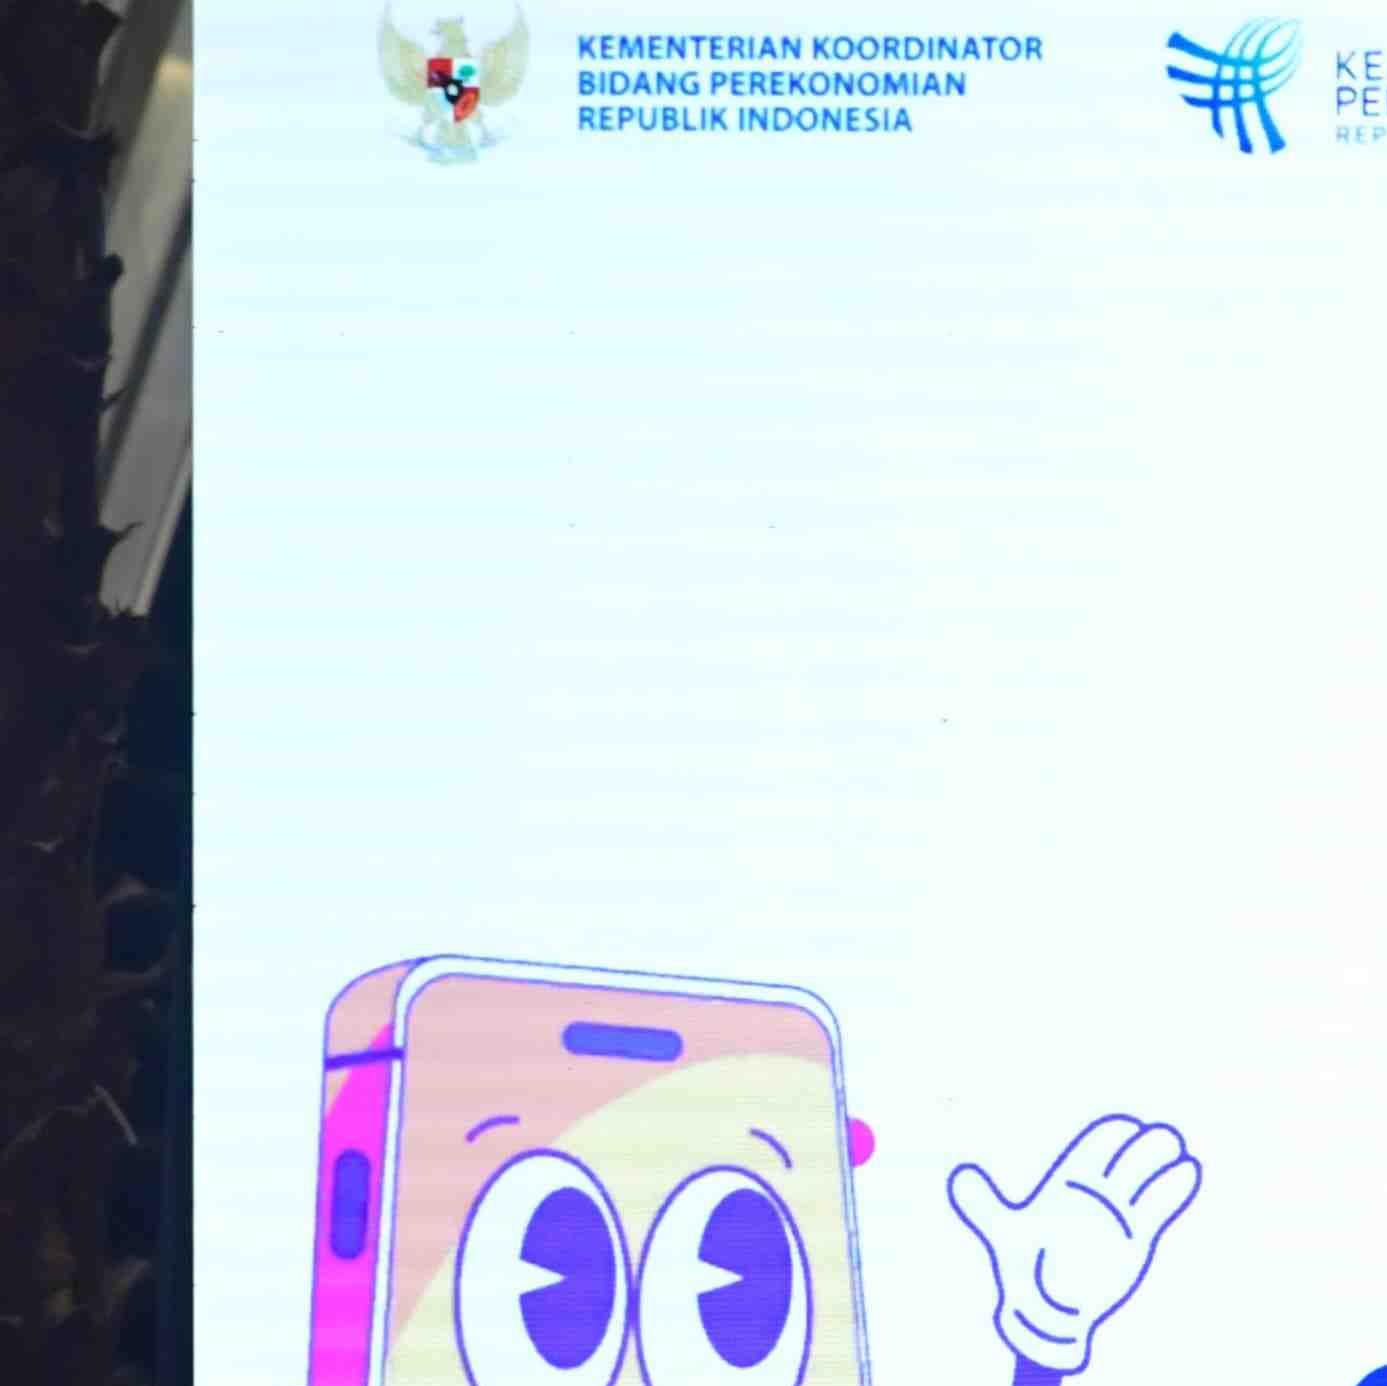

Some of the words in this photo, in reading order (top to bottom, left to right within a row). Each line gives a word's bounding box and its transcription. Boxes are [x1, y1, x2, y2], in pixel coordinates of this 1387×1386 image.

[577, 36, 800, 61] KEMENTERIAN
[812, 36, 1043, 61] KOORDINATOR
[577, 71, 699, 97] BIDANG
[711, 71, 968, 97] PEREKONOMIAN
[577, 106, 729, 132] REPUBLIK
[738, 106, 913, 132] INDONESIA
